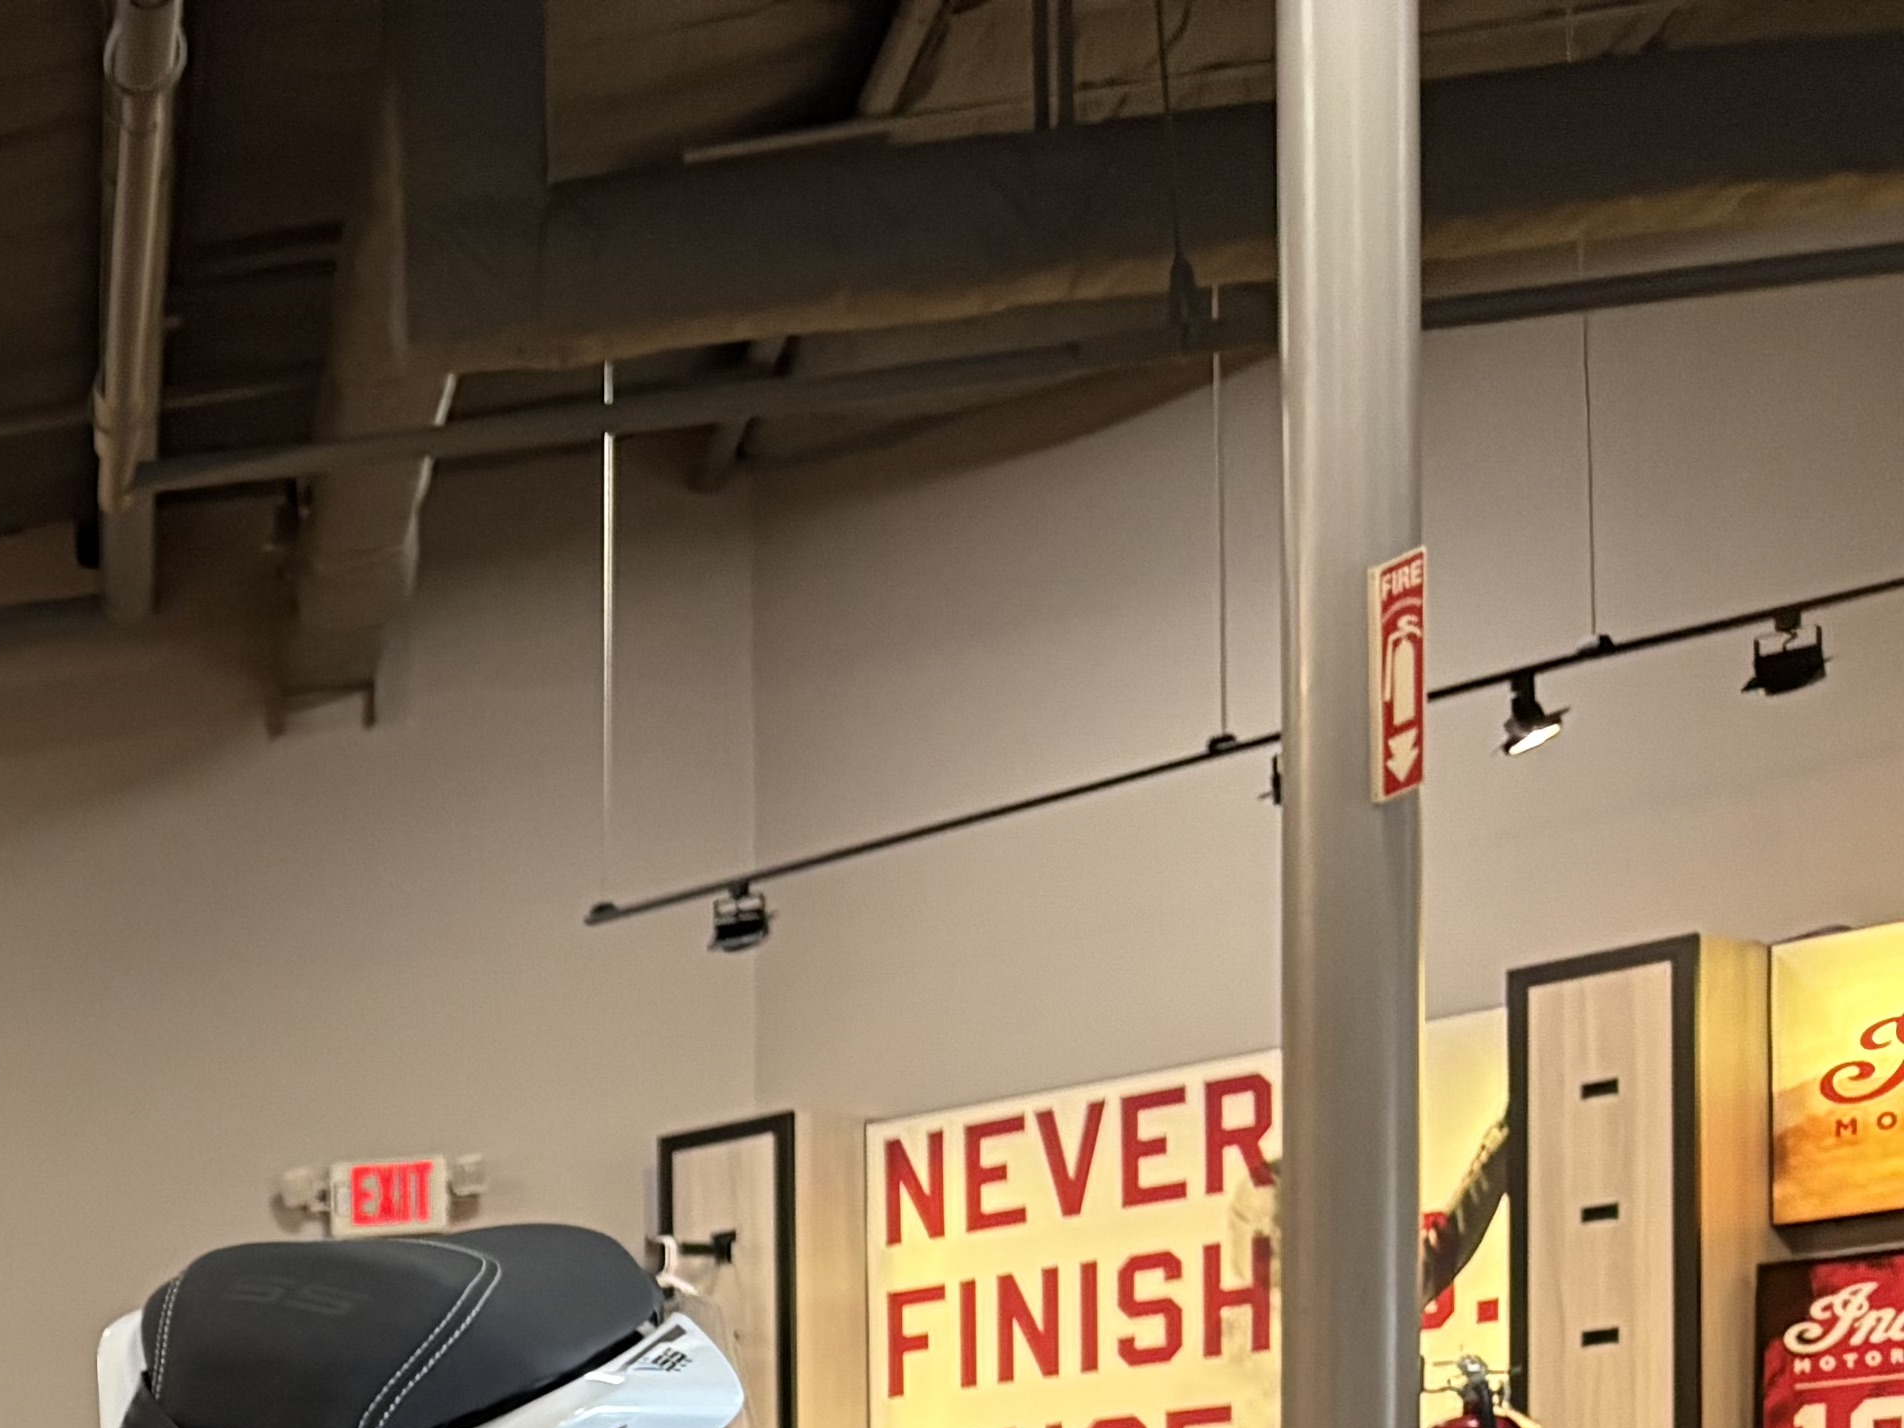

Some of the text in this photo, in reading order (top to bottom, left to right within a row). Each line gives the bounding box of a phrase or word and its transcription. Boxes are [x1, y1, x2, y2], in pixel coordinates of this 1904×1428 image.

[1382, 559, 1423, 601] FIRE
[351, 1160, 433, 1226] EXIT
[884, 1073, 1275, 1247] NEVER
